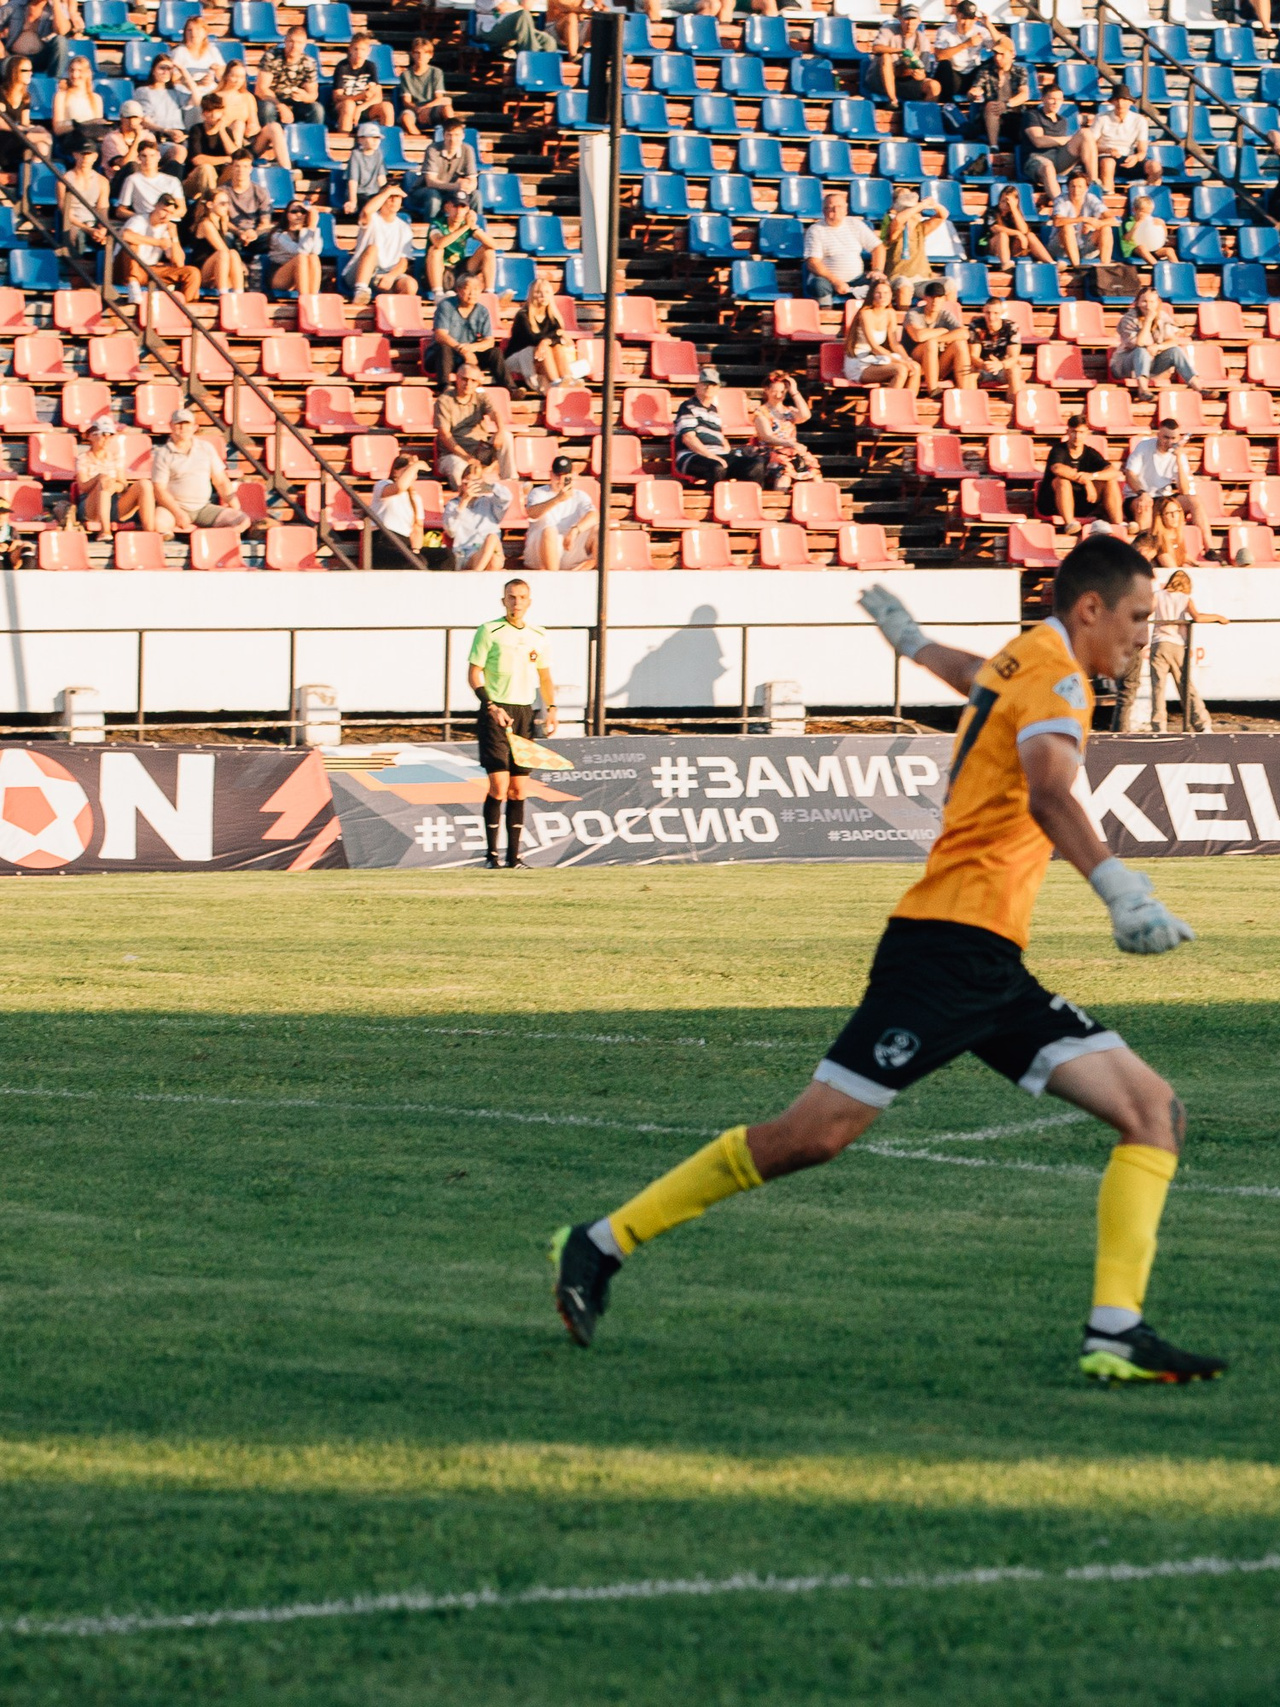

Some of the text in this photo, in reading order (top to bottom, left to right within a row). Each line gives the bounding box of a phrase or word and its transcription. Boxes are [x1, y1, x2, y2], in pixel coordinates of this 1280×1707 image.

[582, 753, 647, 764] #ЗАМИР
[540, 768, 638, 783] #ЗАРОССИЮ
[651, 755, 940, 799] #ЗАМИР
[780, 808, 874, 823] #ЗАМИР
[827, 828, 936, 842] #ЗАРОССИЮ
